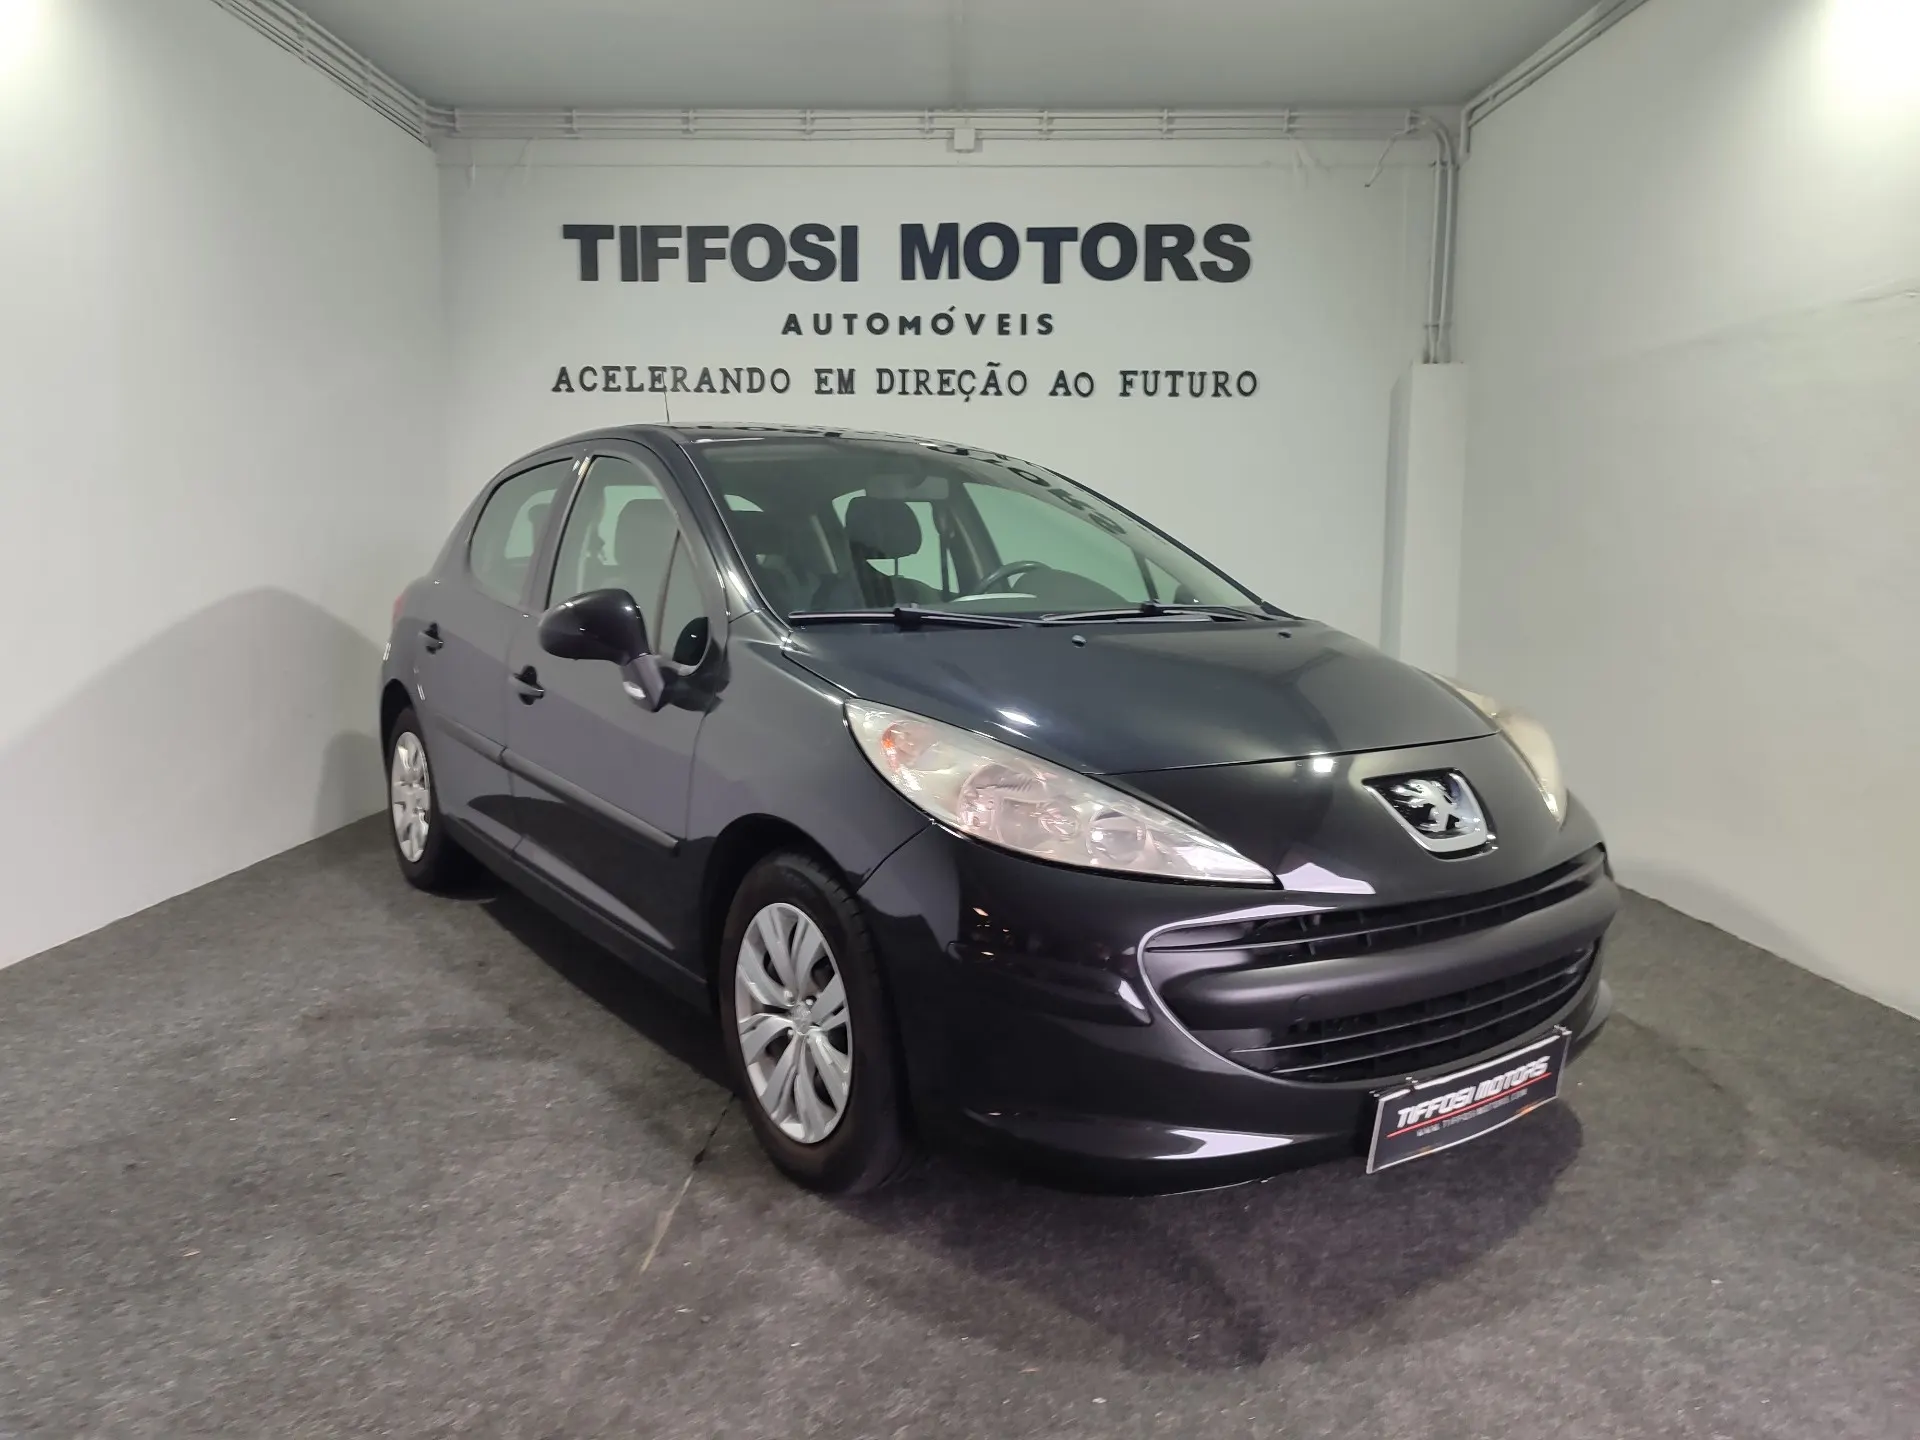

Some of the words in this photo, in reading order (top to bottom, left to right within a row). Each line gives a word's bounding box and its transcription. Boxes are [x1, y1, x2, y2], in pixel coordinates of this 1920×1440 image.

[562, 223, 859, 283] TIFFOSI
[900, 222, 1251, 284] MOTORS
[782, 306, 1054, 336] AUTOMÓVEIS
[551, 366, 791, 394] ACELERANDO
[814, 368, 857, 395] EM
[876, 362, 1028, 403] DIREÇÃO
[1049, 370, 1095, 398] AO
[1119, 370, 1259, 398] FUTURO
[1397, 1087, 1476, 1128] TIFFOSI
[1474, 1057, 1551, 1101] MOTORS
